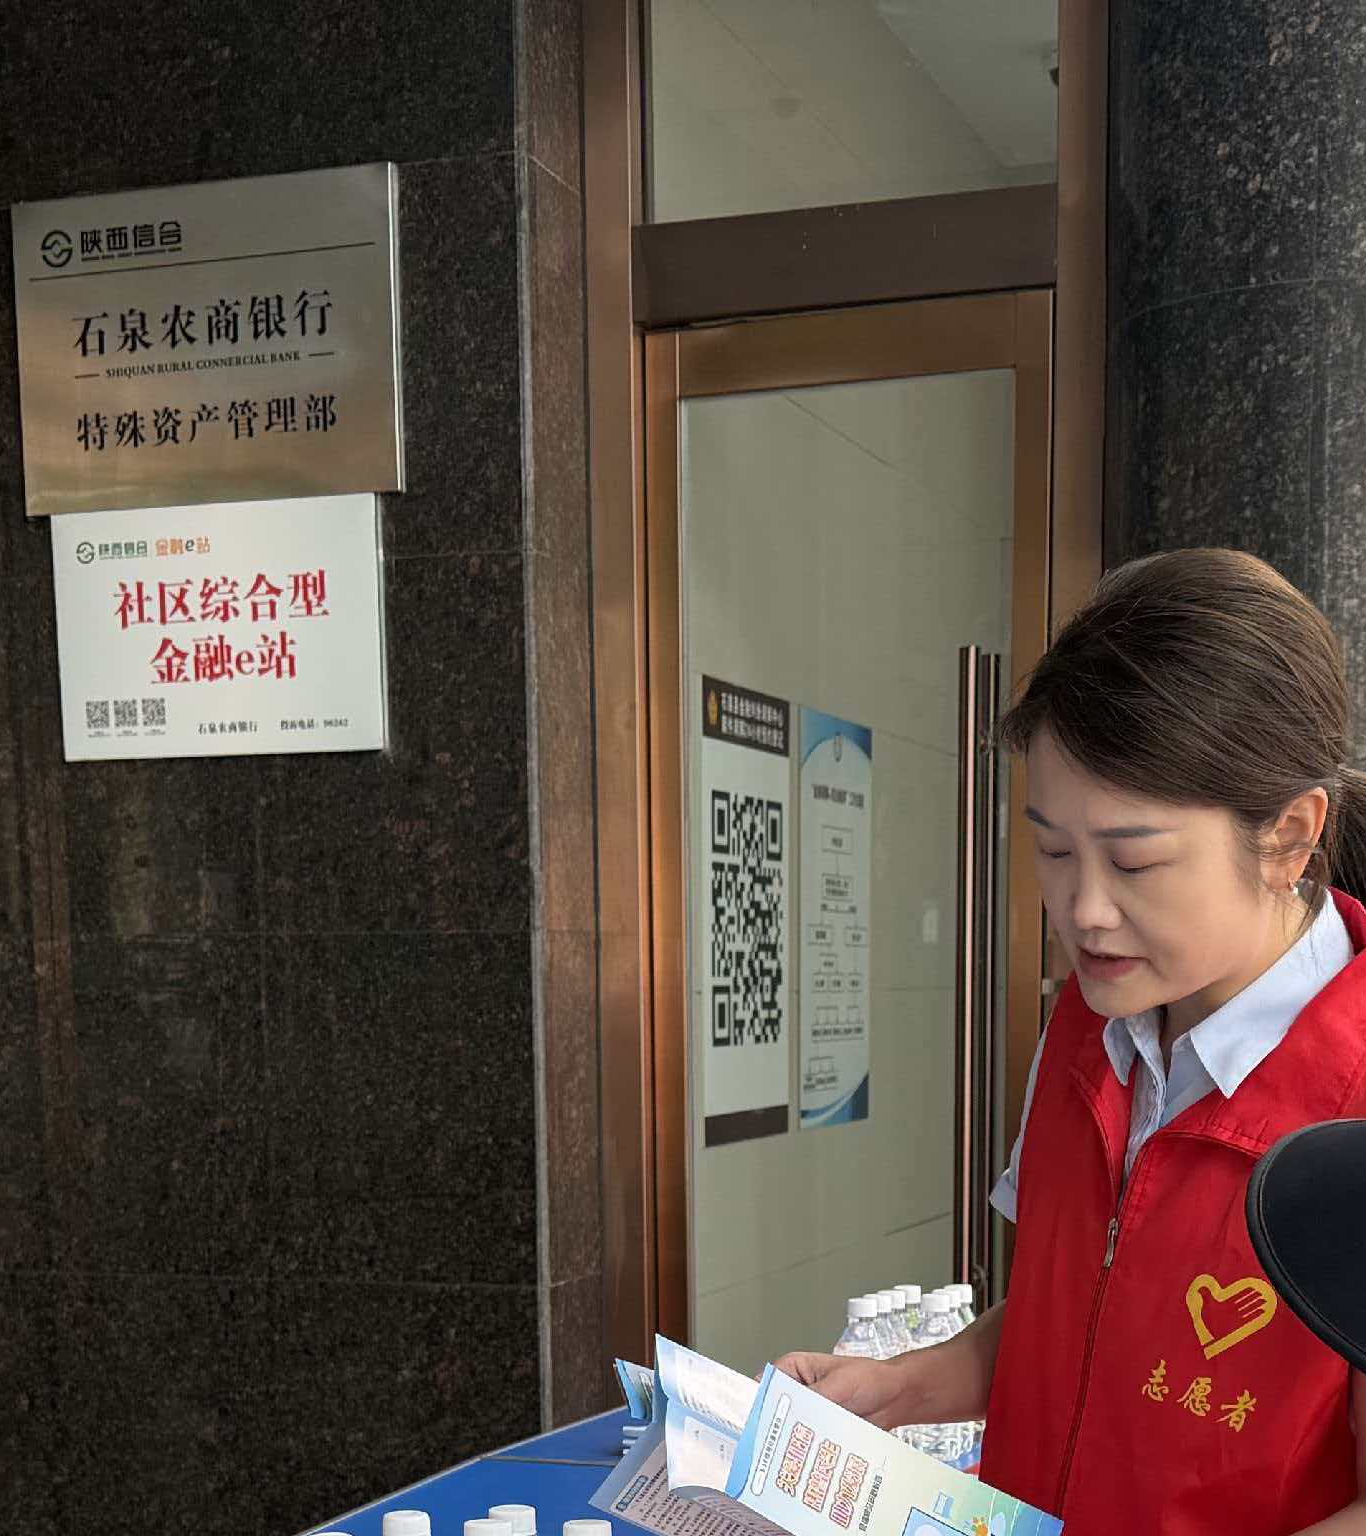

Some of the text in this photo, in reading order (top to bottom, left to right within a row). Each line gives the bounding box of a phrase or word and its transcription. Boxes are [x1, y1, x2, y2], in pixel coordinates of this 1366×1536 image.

[80, 220, 182, 254] 陕西信合
[71, 289, 334, 358] 石泉农商银行
[105, 363, 155, 379] SHIQUAN
[157, 359, 194, 373] RURAL
[270, 350, 301, 363] BANK
[76, 393, 337, 451] 特殊资产管理部
[113, 568, 330, 630] 社区综合型
[150, 631, 297, 684] 金融e站
[198, 720, 258, 735] 石泉农商银行
[1141, 1359, 1258, 1433] 志愿者
